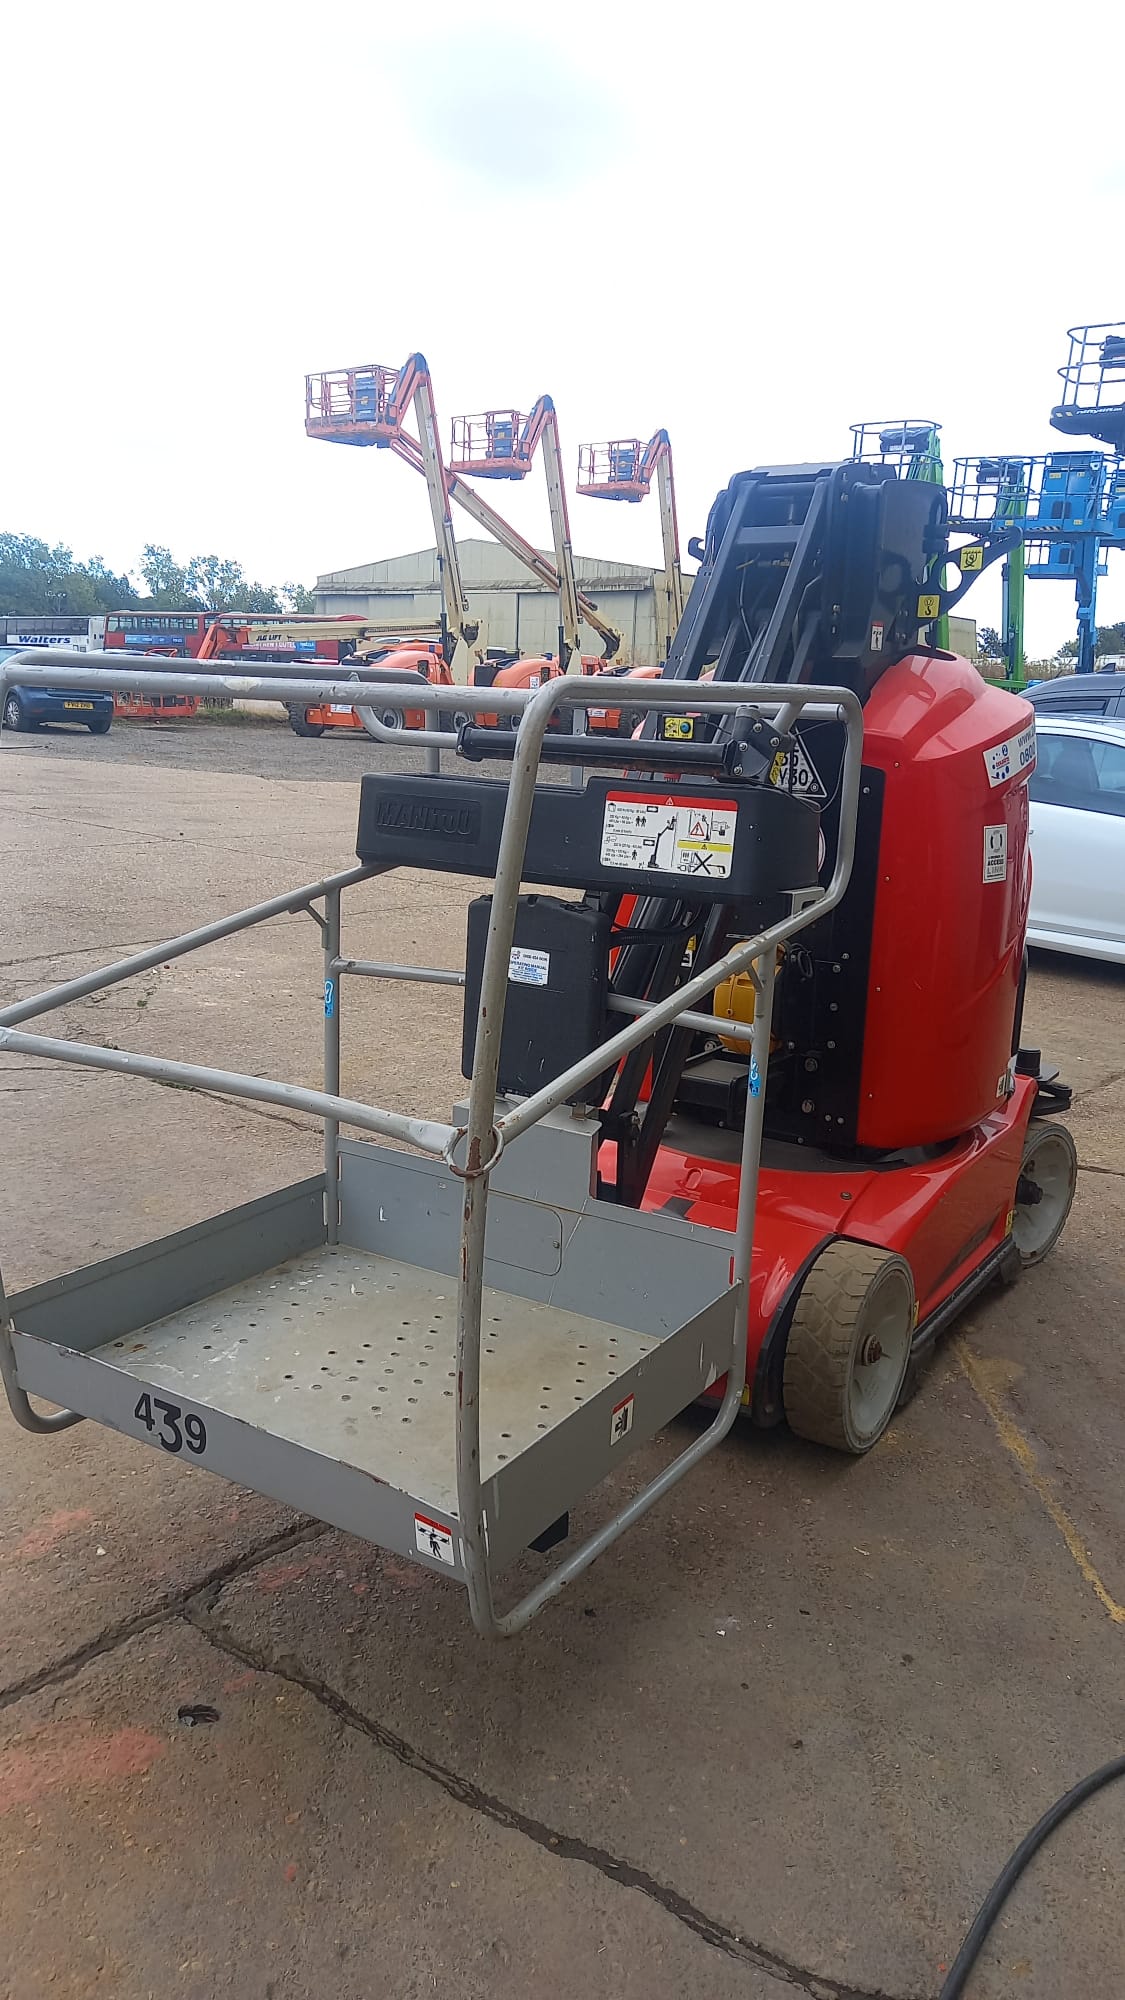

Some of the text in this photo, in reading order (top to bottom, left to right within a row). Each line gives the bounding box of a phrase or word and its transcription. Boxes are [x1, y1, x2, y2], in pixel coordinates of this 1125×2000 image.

[18, 635, 71, 644] Walters
[377, 801, 471, 835] MANITOU
[134, 1392, 207, 1455] 439
